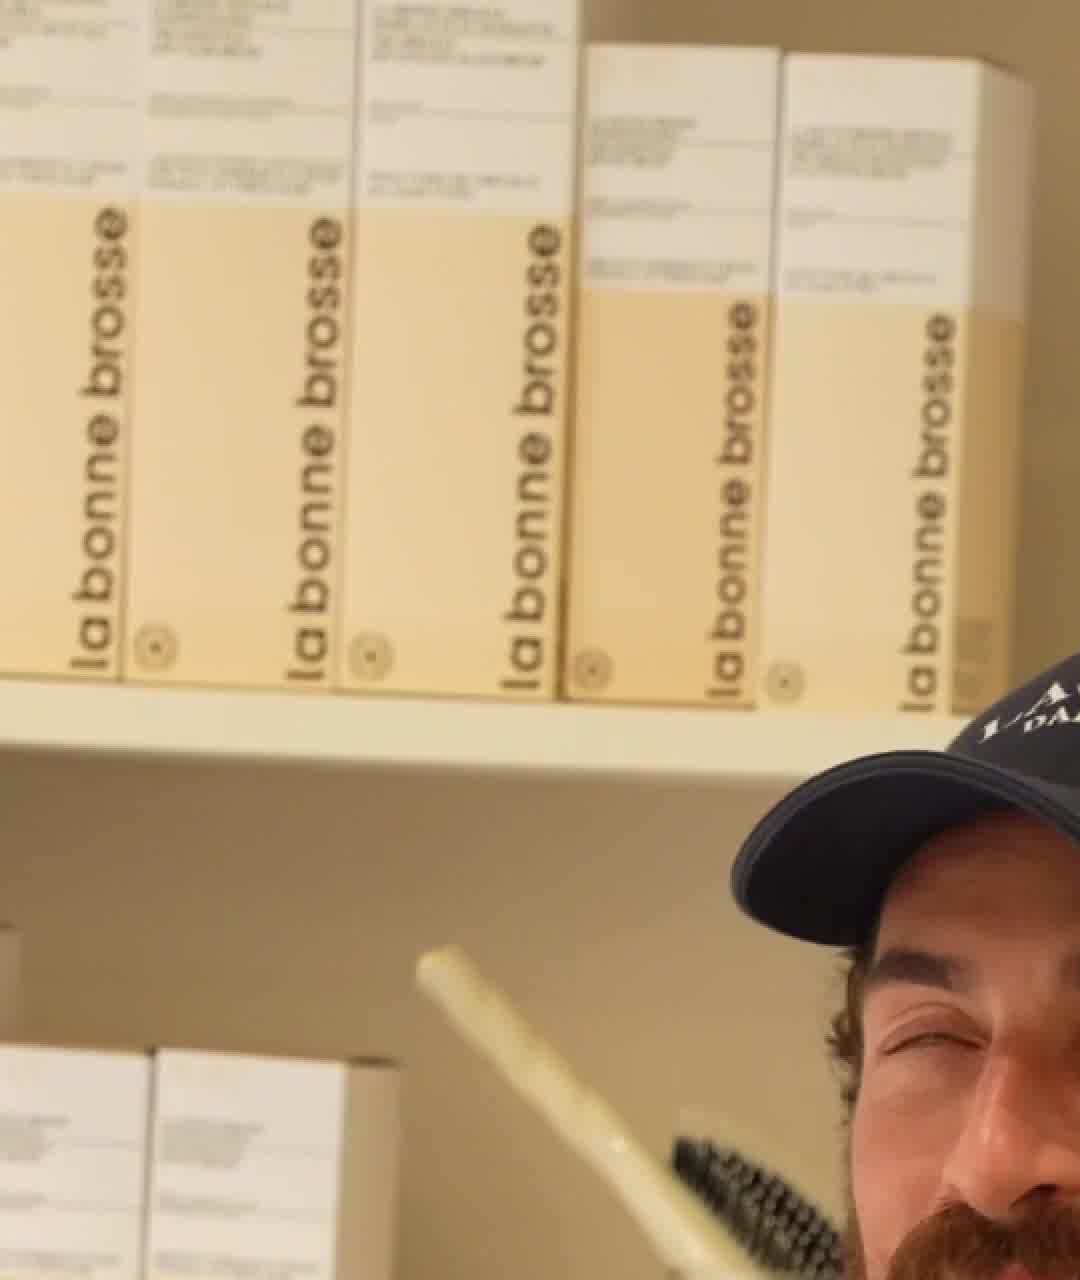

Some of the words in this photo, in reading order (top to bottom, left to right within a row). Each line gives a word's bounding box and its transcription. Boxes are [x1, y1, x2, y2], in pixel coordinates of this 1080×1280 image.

[78, 205, 129, 398] brosse
[297, 216, 344, 409] brosse
[514, 223, 563, 416] brosse
[715, 301, 759, 466] brosse
[913, 314, 957, 480] brosse
[72, 414, 119, 602] bonne
[289, 425, 335, 615] bonne
[505, 432, 553, 622] bonne
[709, 479, 751, 641] bonne
[903, 492, 946, 655] bonne
[69, 617, 112, 672] la
[286, 627, 328, 681] la
[500, 637, 543, 691] la
[705, 653, 744, 700] la
[899, 667, 937, 714] la
